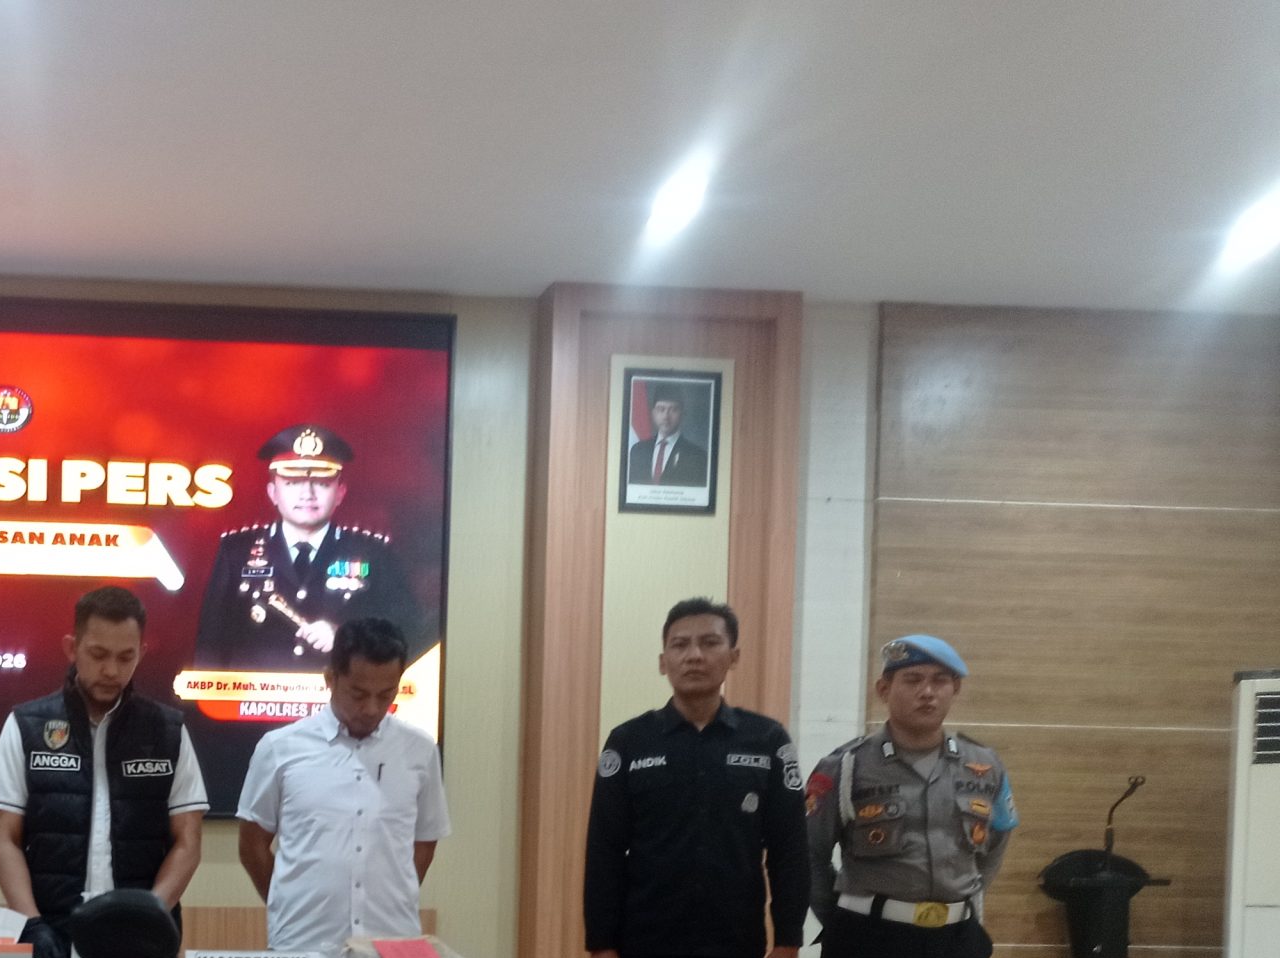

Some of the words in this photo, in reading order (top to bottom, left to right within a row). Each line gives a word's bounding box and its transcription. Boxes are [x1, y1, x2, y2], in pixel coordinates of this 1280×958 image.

[61, 459, 234, 508] PERS
[52, 532, 120, 547] ANAK
[187, 681, 214, 690] AKBP
[216, 681, 230, 690] Dr.
[240, 702, 308, 717] KAPOLRES
[33, 755, 77, 768] ANGGA
[126, 762, 168, 775] KASAT
[629, 755, 667, 772] ANDIK
